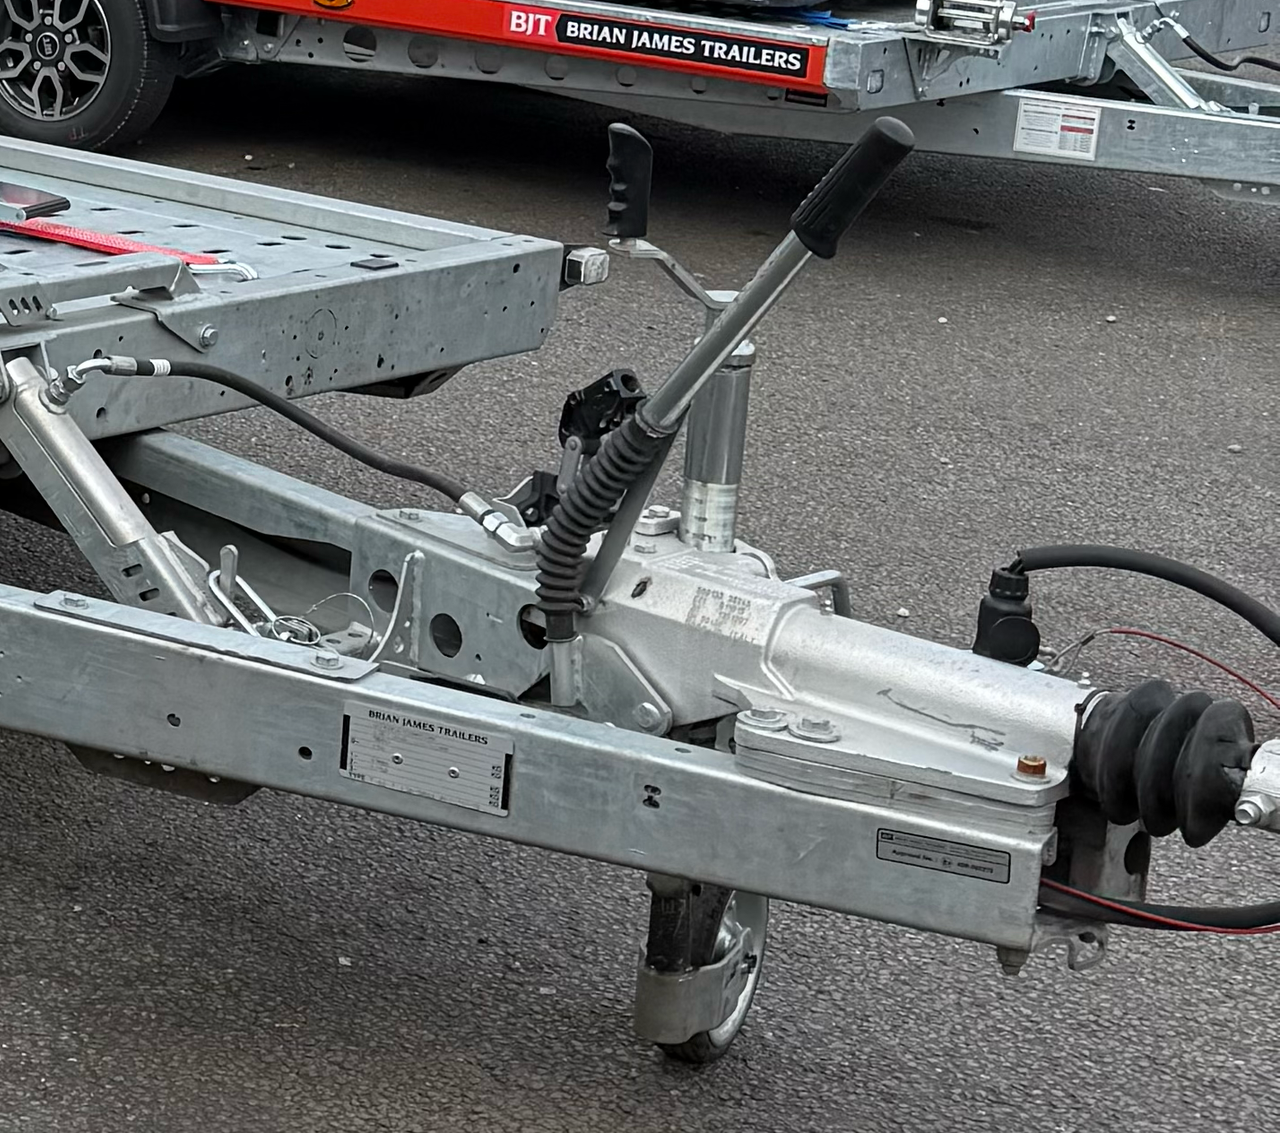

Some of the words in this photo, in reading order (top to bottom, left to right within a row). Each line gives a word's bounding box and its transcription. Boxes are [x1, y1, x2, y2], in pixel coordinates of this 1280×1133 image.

[510, 11, 552, 36] BJT
[566, 21, 626, 44] BRIAN
[631, 29, 695, 55] JAMES
[701, 40, 801, 70] TRAILERS
[368, 709, 399, 725] BRIAN
[402, 719, 435, 733] JAMES
[438, 726, 489, 745] TRAILERS
